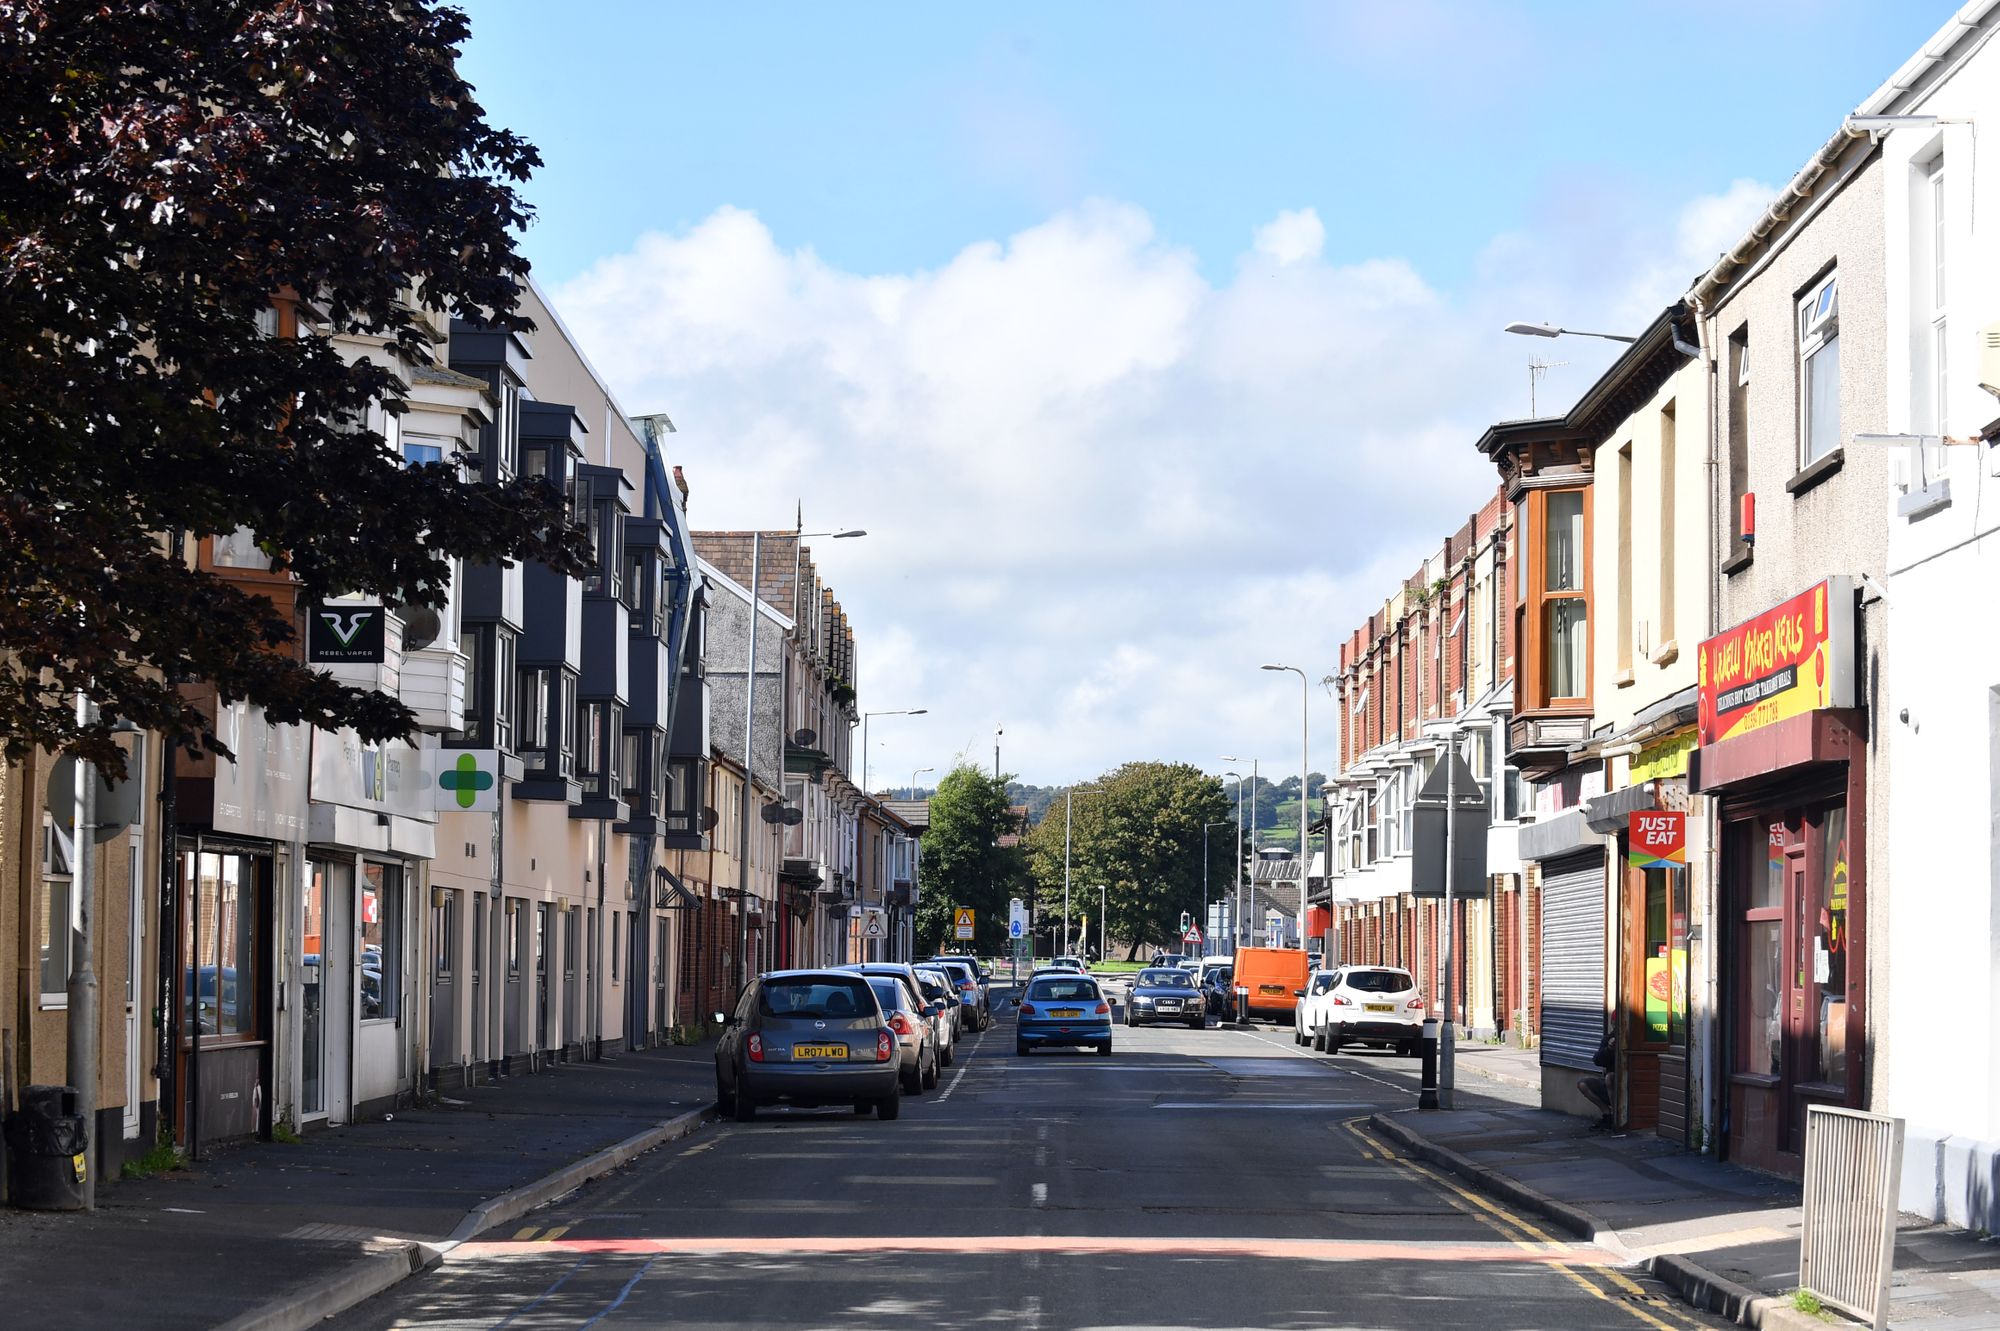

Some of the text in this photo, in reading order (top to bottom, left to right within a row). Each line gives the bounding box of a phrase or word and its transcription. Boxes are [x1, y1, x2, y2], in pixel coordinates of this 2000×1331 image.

[1774, 613, 1804, 663] MEALS
[1638, 817, 1677, 832] JUST
[1645, 832, 1677, 845] EAT
[798, 1047, 822, 1057] LR07
